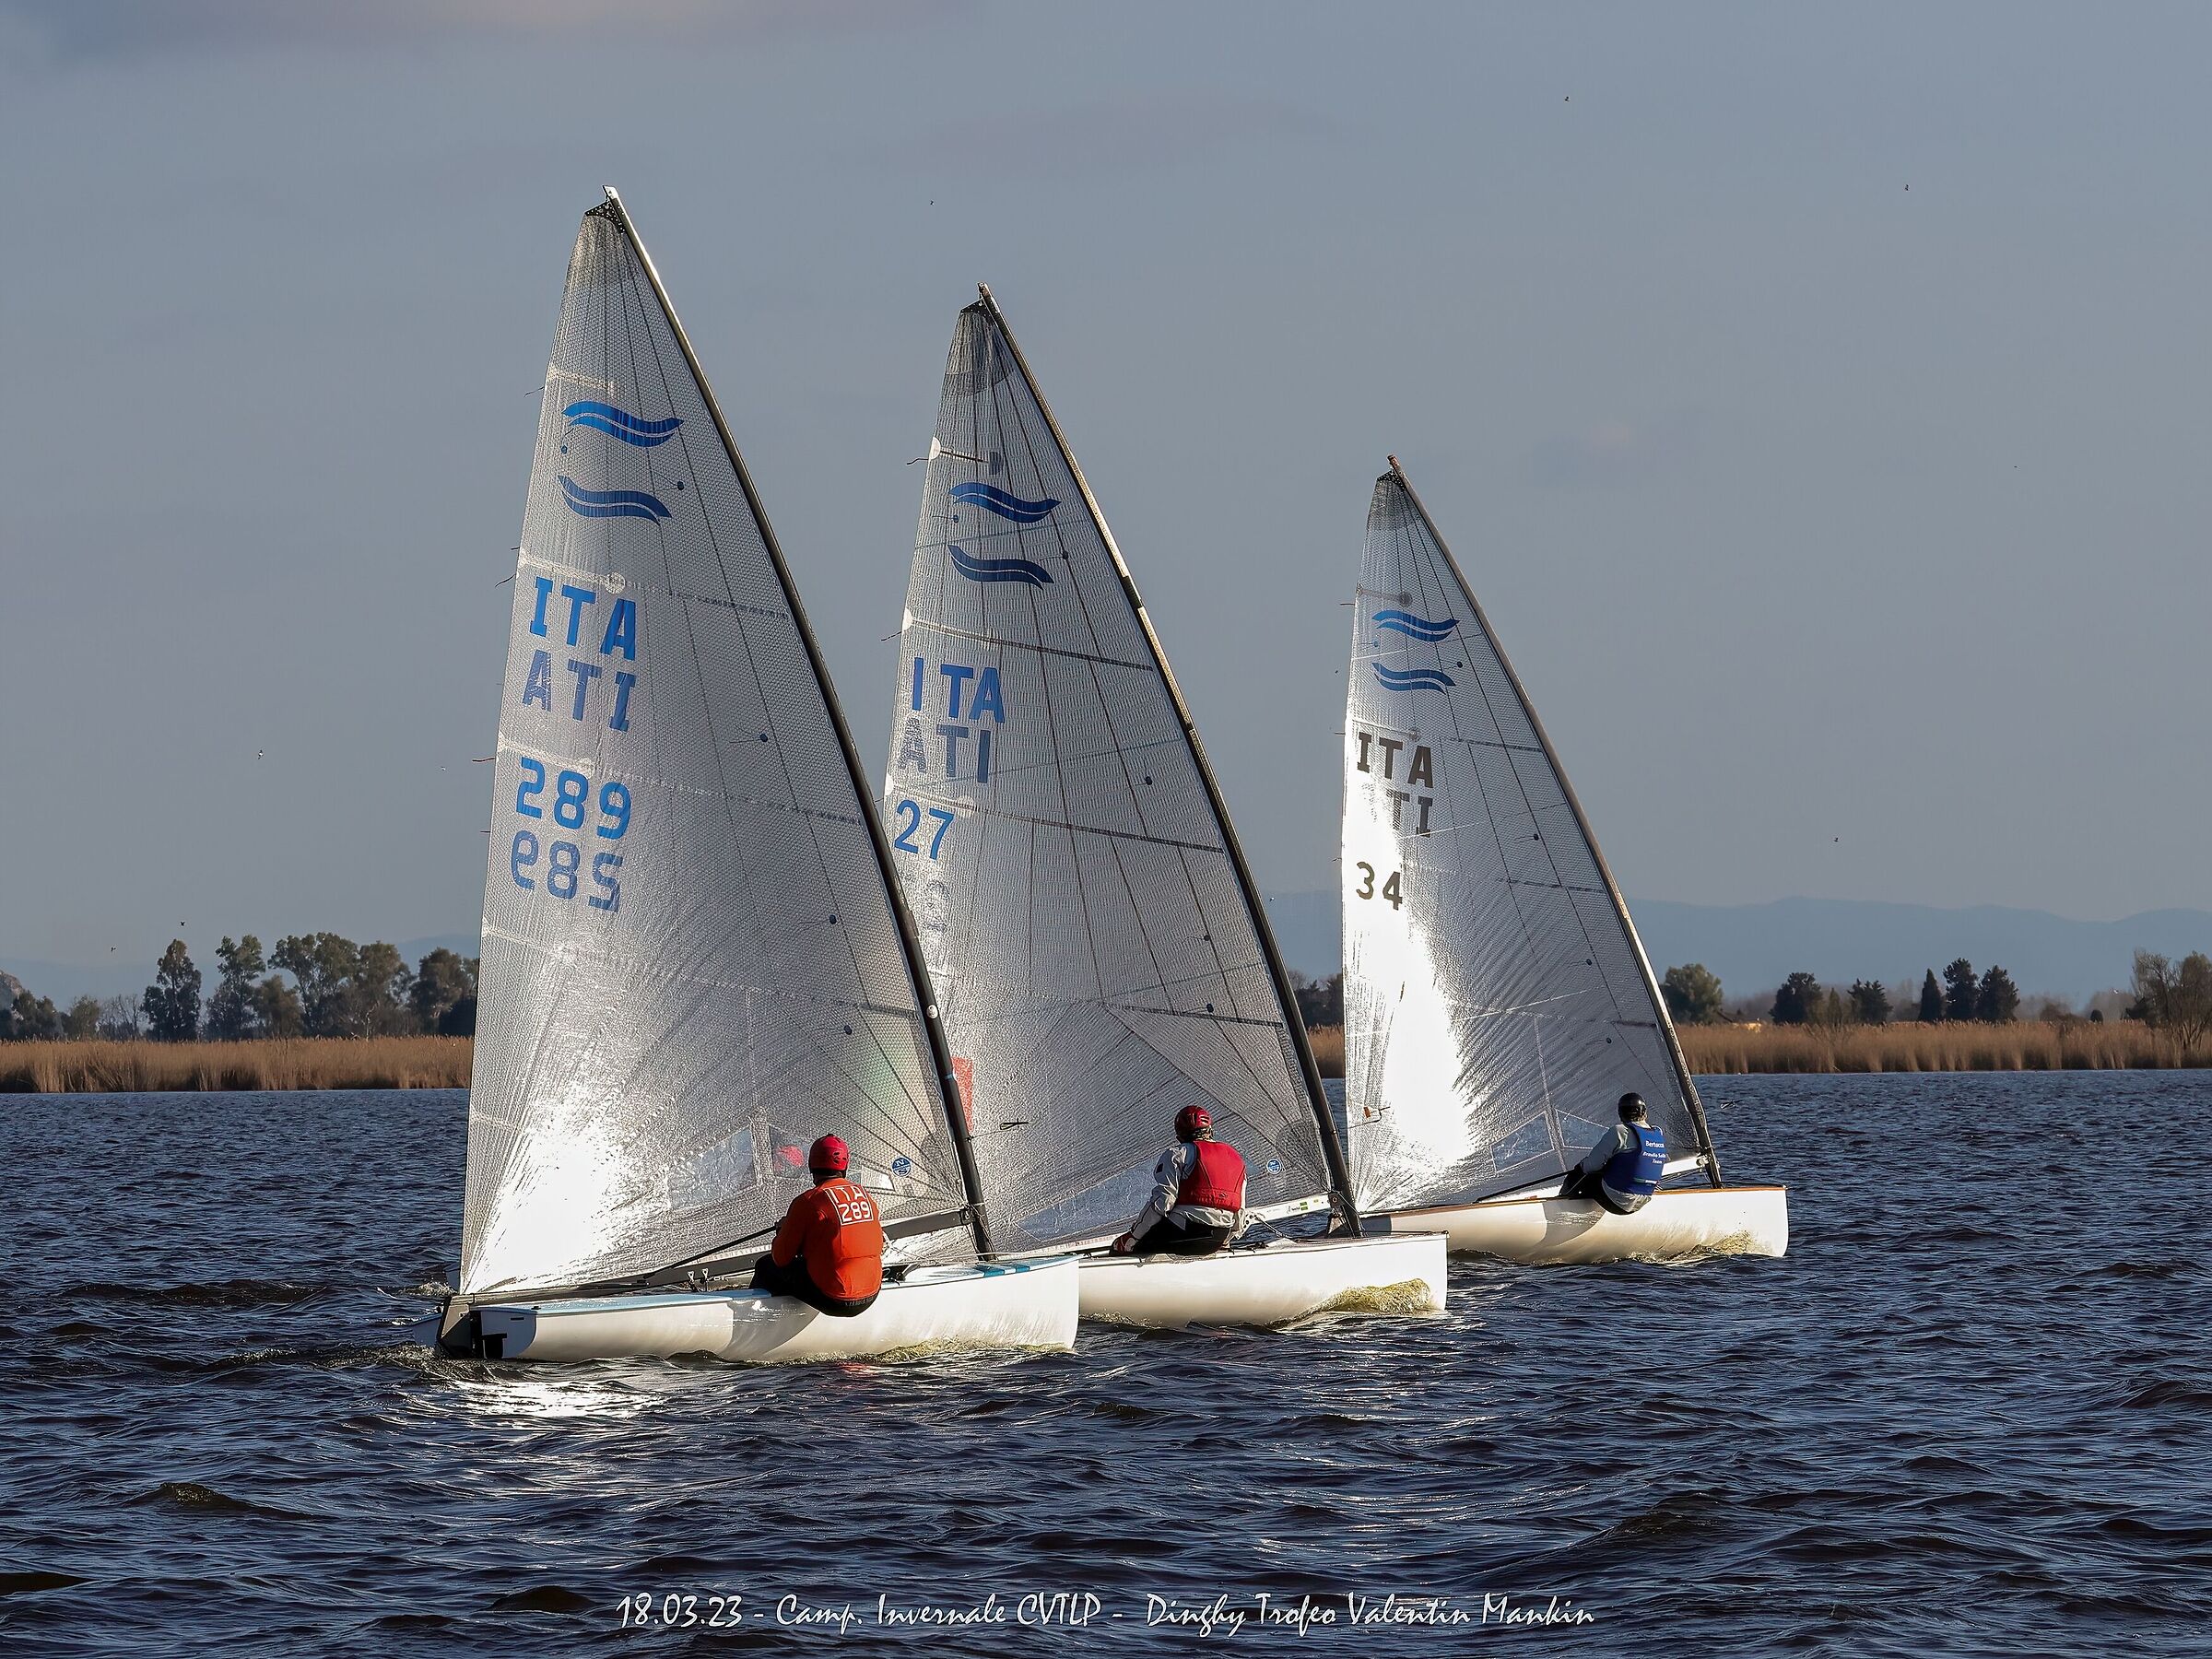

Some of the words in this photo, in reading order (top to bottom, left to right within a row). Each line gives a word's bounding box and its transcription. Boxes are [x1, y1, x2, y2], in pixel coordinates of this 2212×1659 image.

[529, 576, 636, 662] ITA
[912, 656, 1006, 724] ITA
[1357, 731, 1433, 788] ITA
[515, 757, 632, 840] 289
[894, 799, 955, 860] 27
[1356, 861, 1403, 911] 34
[829, 1186, 867, 1204] ITA
[838, 1201, 871, 1222] 289
